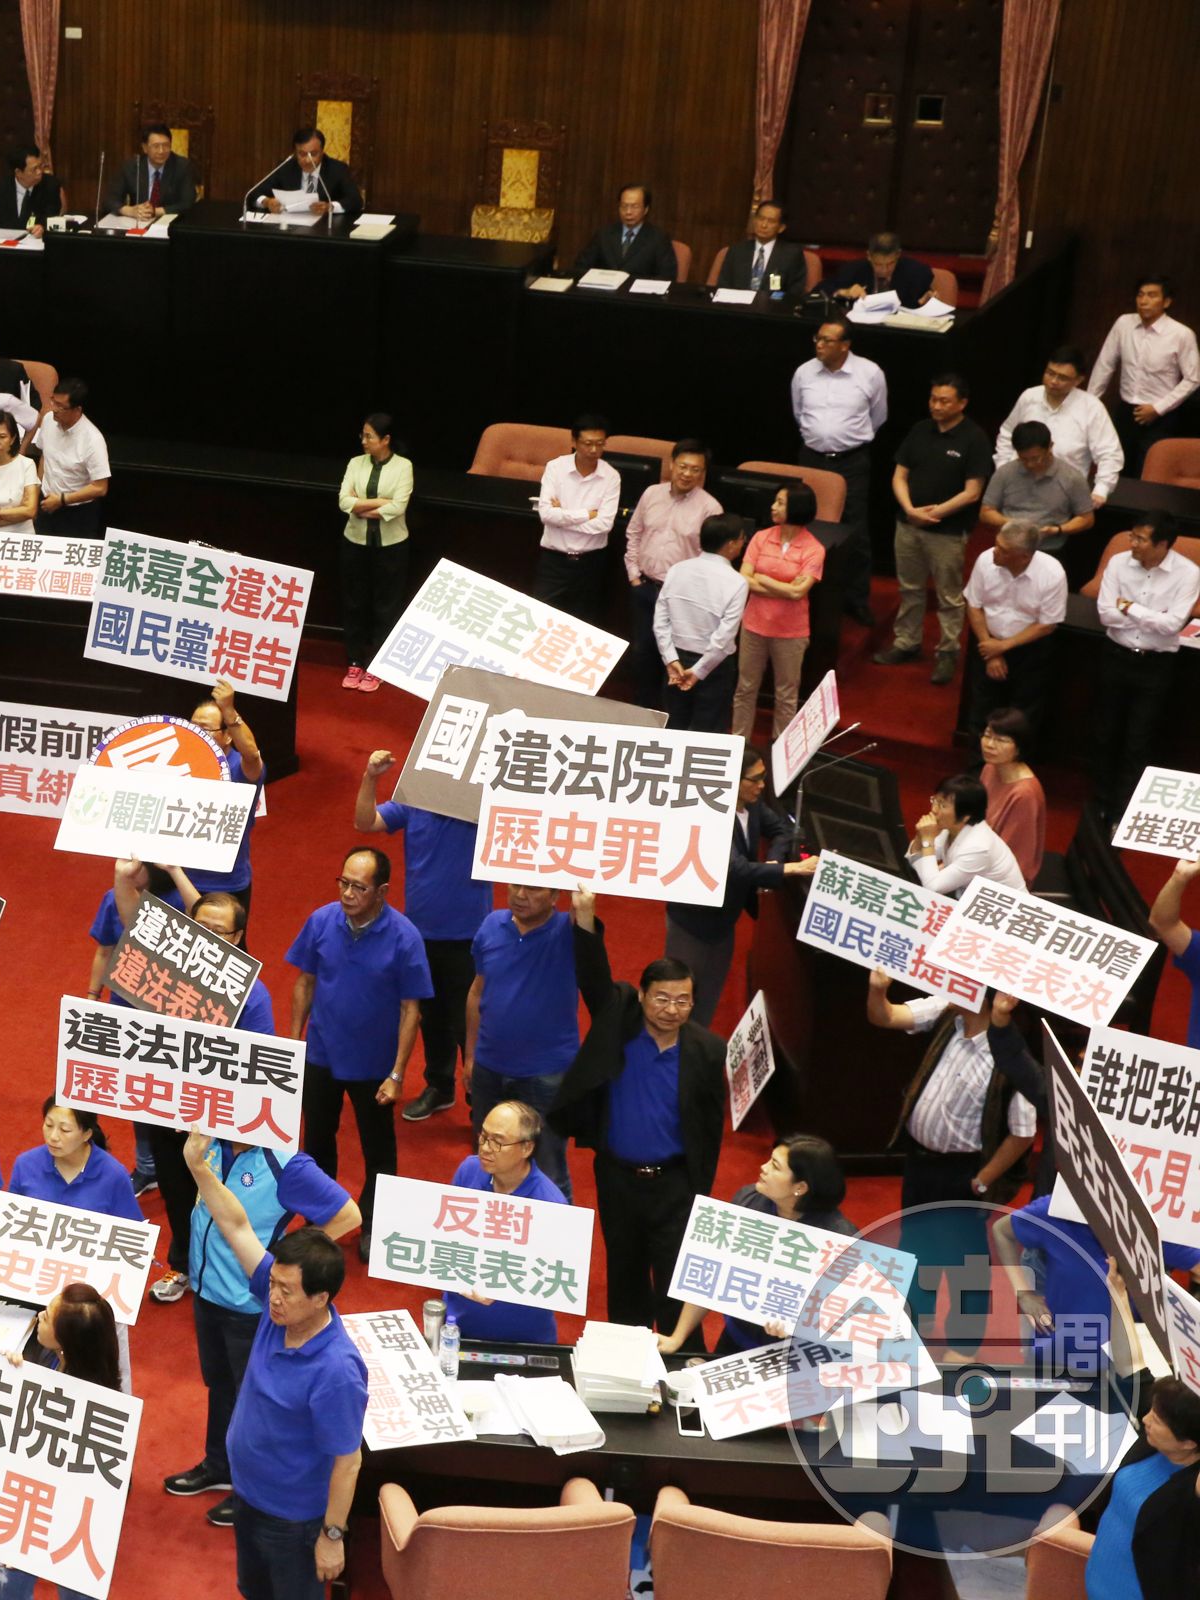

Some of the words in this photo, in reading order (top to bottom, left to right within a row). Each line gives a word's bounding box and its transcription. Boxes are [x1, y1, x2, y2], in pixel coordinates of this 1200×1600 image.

[102, 540, 304, 628] 蘇嘉全違法
[91, 601, 292, 690] 國民黨提告
[415, 569, 613, 691] 蘇嘉全違法
[490, 729, 733, 814] 違法院長
[105, 790, 248, 845] 閹割立法權
[479, 805, 719, 893] 歷史罪人
[1123, 811, 1200, 853] 摧毀
[129, 901, 252, 1007] 違法院長
[938, 926, 1114, 1023] 逐案表決
[962, 887, 1142, 980] 嚴審前瞻
[64, 1009, 299, 1095] 違法院長
[62, 1059, 293, 1144] 歷史罪人
[433, 1194, 534, 1246] 反對
[1051, 1065, 1167, 1333] 民主已死
[381, 1231, 579, 1304] 包裹表決
[689, 1204, 906, 1300] 蘇嘉全違法
[676, 1252, 893, 1350] 國民黨提告
[366, 1313, 464, 1440] 在野一致要求
[699, 1337, 860, 1396] 嚴審前
